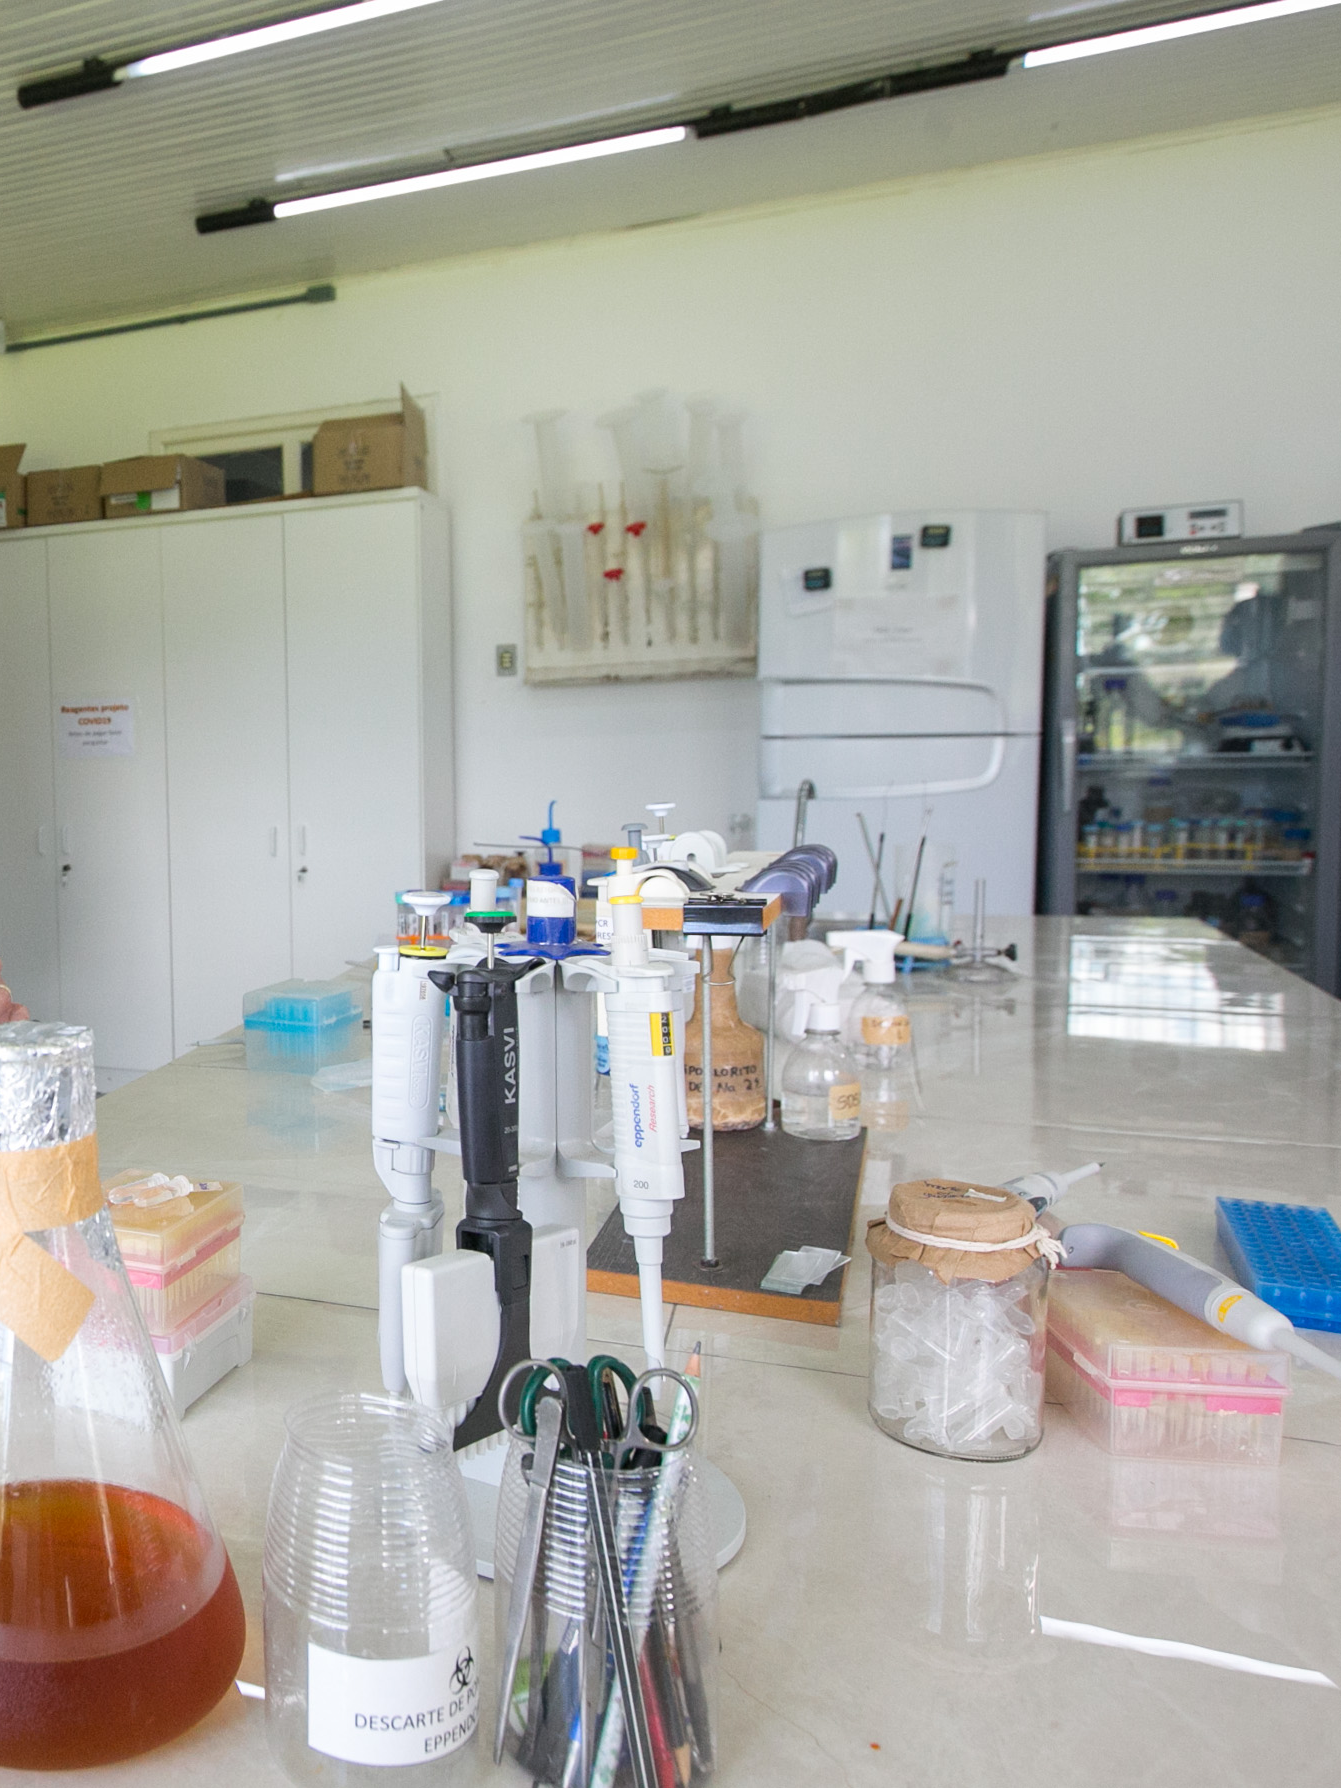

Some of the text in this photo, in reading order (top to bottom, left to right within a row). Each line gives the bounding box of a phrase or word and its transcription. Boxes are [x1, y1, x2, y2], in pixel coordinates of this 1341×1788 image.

[504, 1027, 517, 1104] KASVI
[629, 1083, 646, 1148] eppendorf
[647, 1084, 658, 1133] Research
[633, 1180, 649, 1190] 200
[354, 1706, 445, 1732] DESCARTE
[449, 1694, 465, 1718] DE
